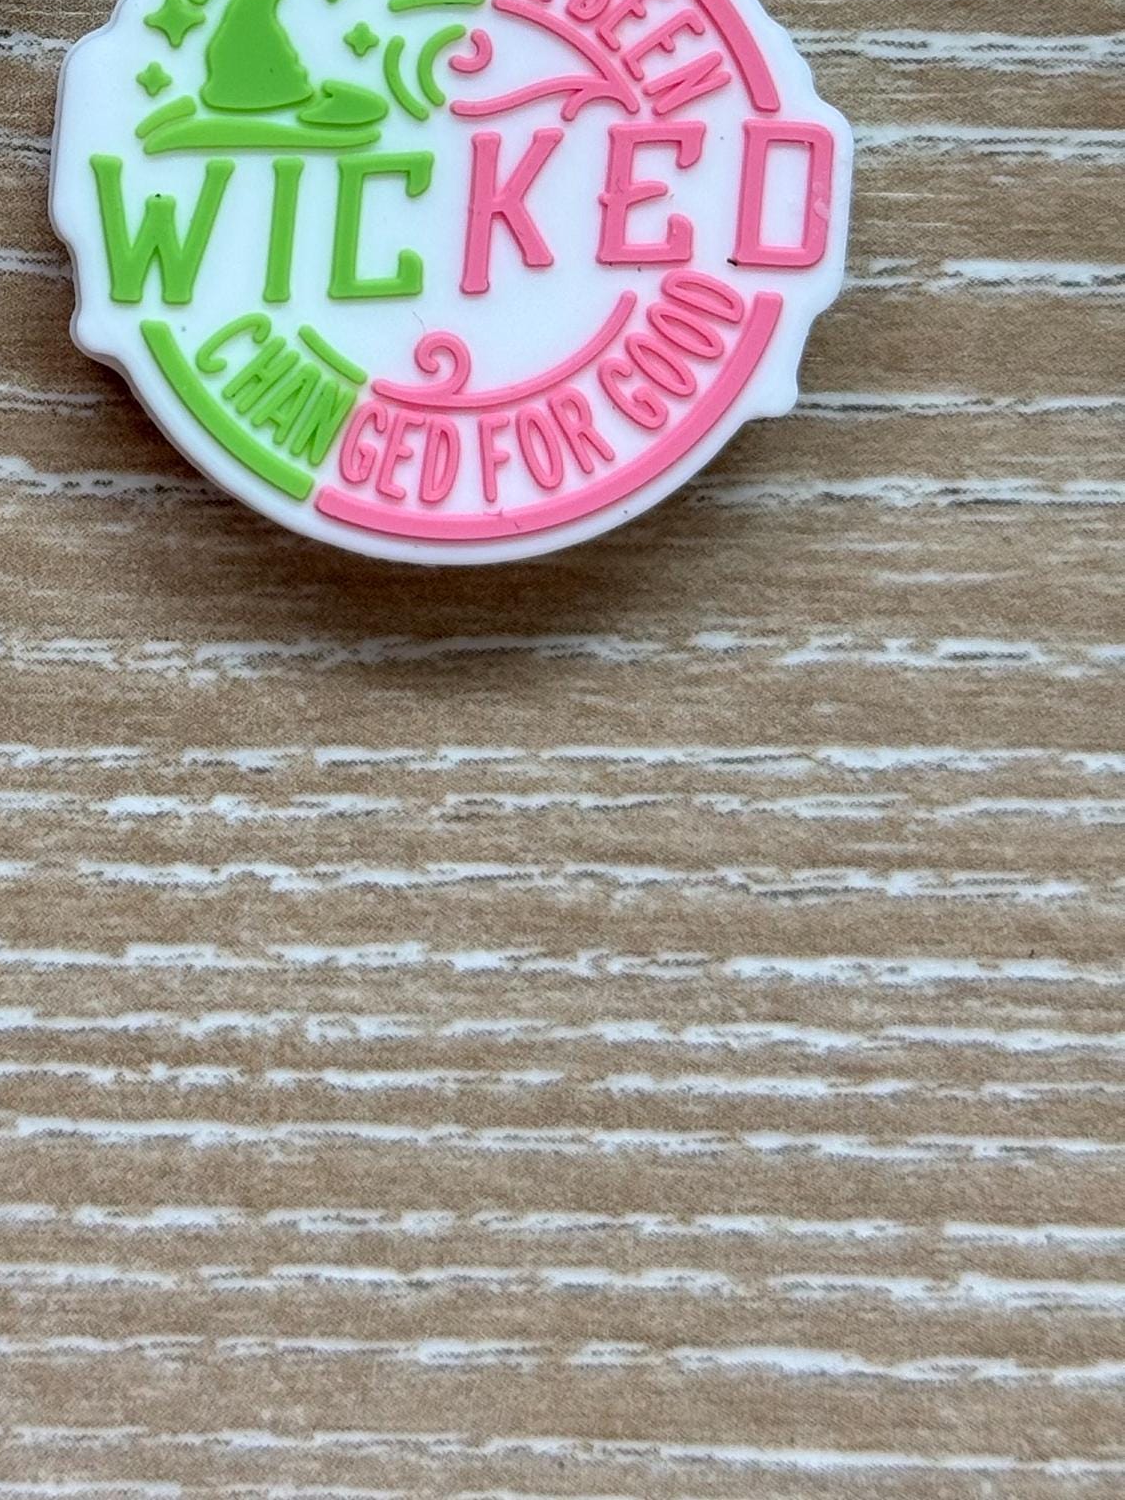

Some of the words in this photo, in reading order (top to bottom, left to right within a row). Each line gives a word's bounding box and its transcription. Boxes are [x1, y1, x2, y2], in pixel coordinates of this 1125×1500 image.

[89, 118, 836, 303] WICKED
[196, 313, 460, 503] CHANGED
[481, 385, 615, 502] FOR
[599, 269, 746, 429] GOOD
